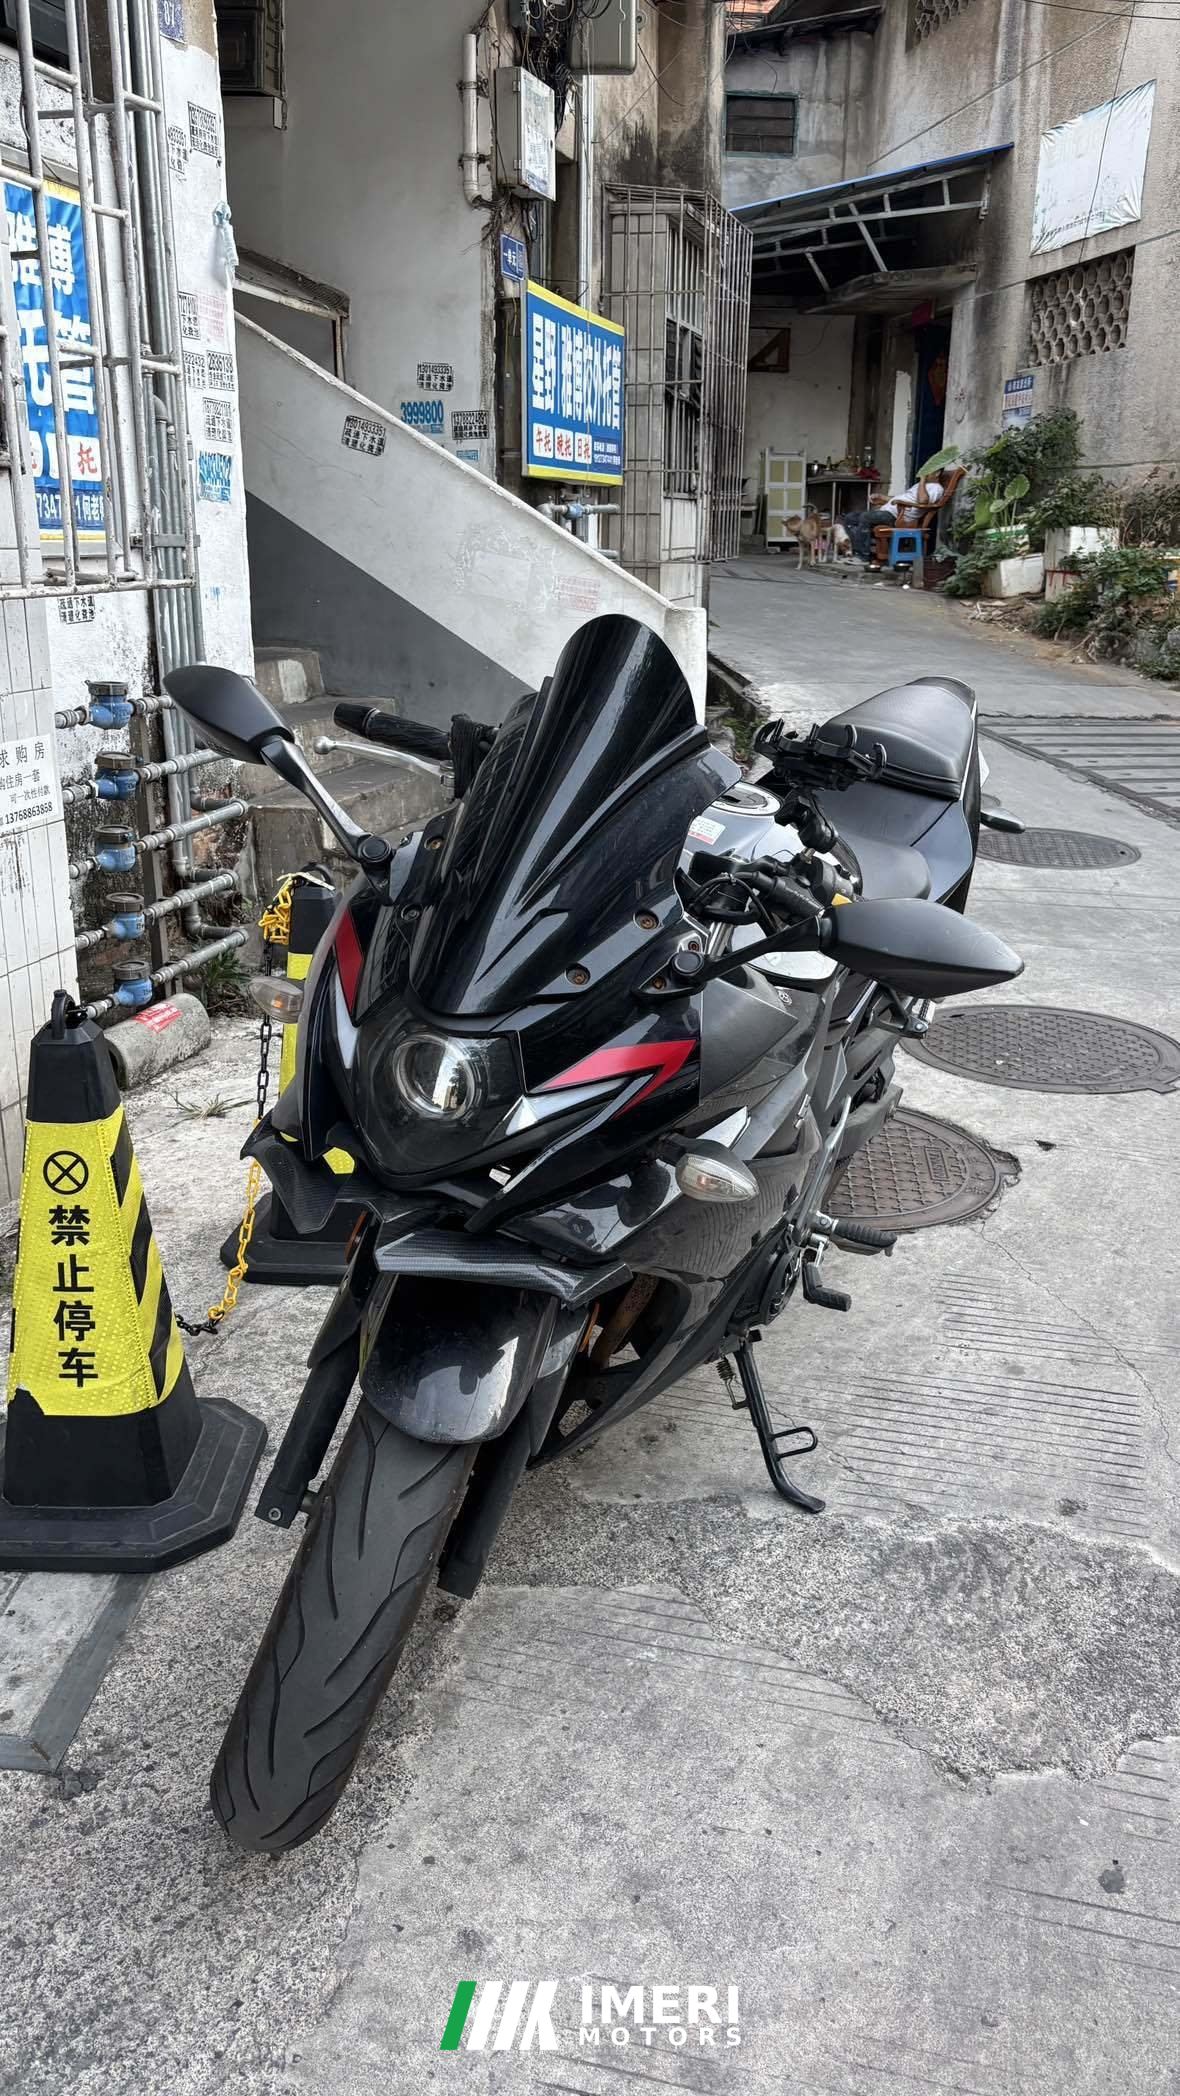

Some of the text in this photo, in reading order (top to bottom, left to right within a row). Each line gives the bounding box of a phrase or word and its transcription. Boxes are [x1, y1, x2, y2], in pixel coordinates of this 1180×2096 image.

[400, 400, 444, 425] 3999800
[49, 1205, 98, 1388] 禁止停车
